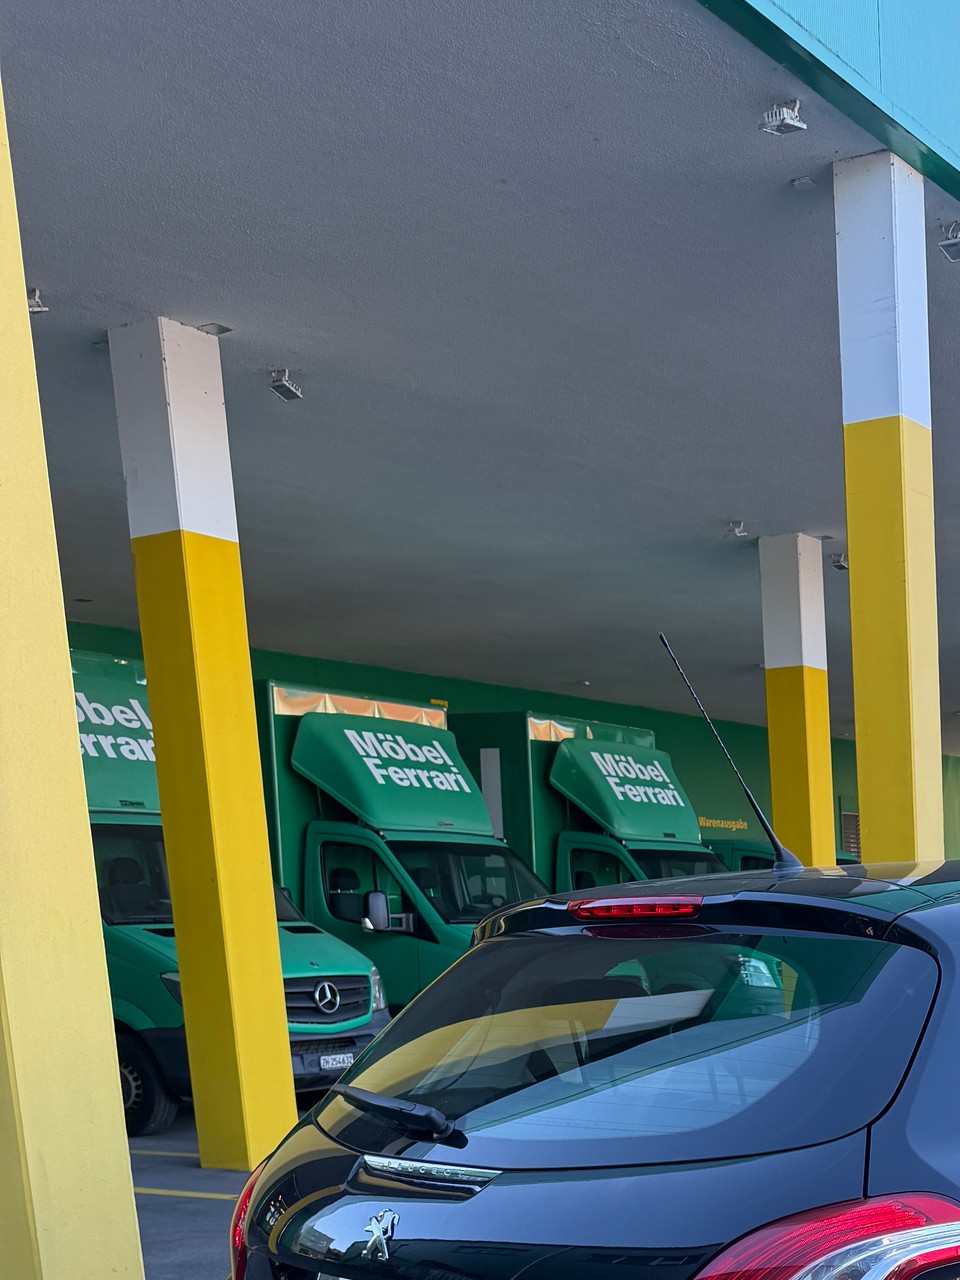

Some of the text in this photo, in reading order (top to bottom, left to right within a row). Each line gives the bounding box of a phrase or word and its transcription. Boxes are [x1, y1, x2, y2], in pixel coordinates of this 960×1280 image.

[75, 692, 153, 730] bel
[344, 729, 454, 766] Möbel
[362, 757, 472, 793] Ferrari
[590, 751, 671, 783] Möbel
[605, 776, 685, 807] Ferrari
[698, 816, 748, 832] Warenausgabe
[382, 1160, 465, 1177] PEUGEOT
